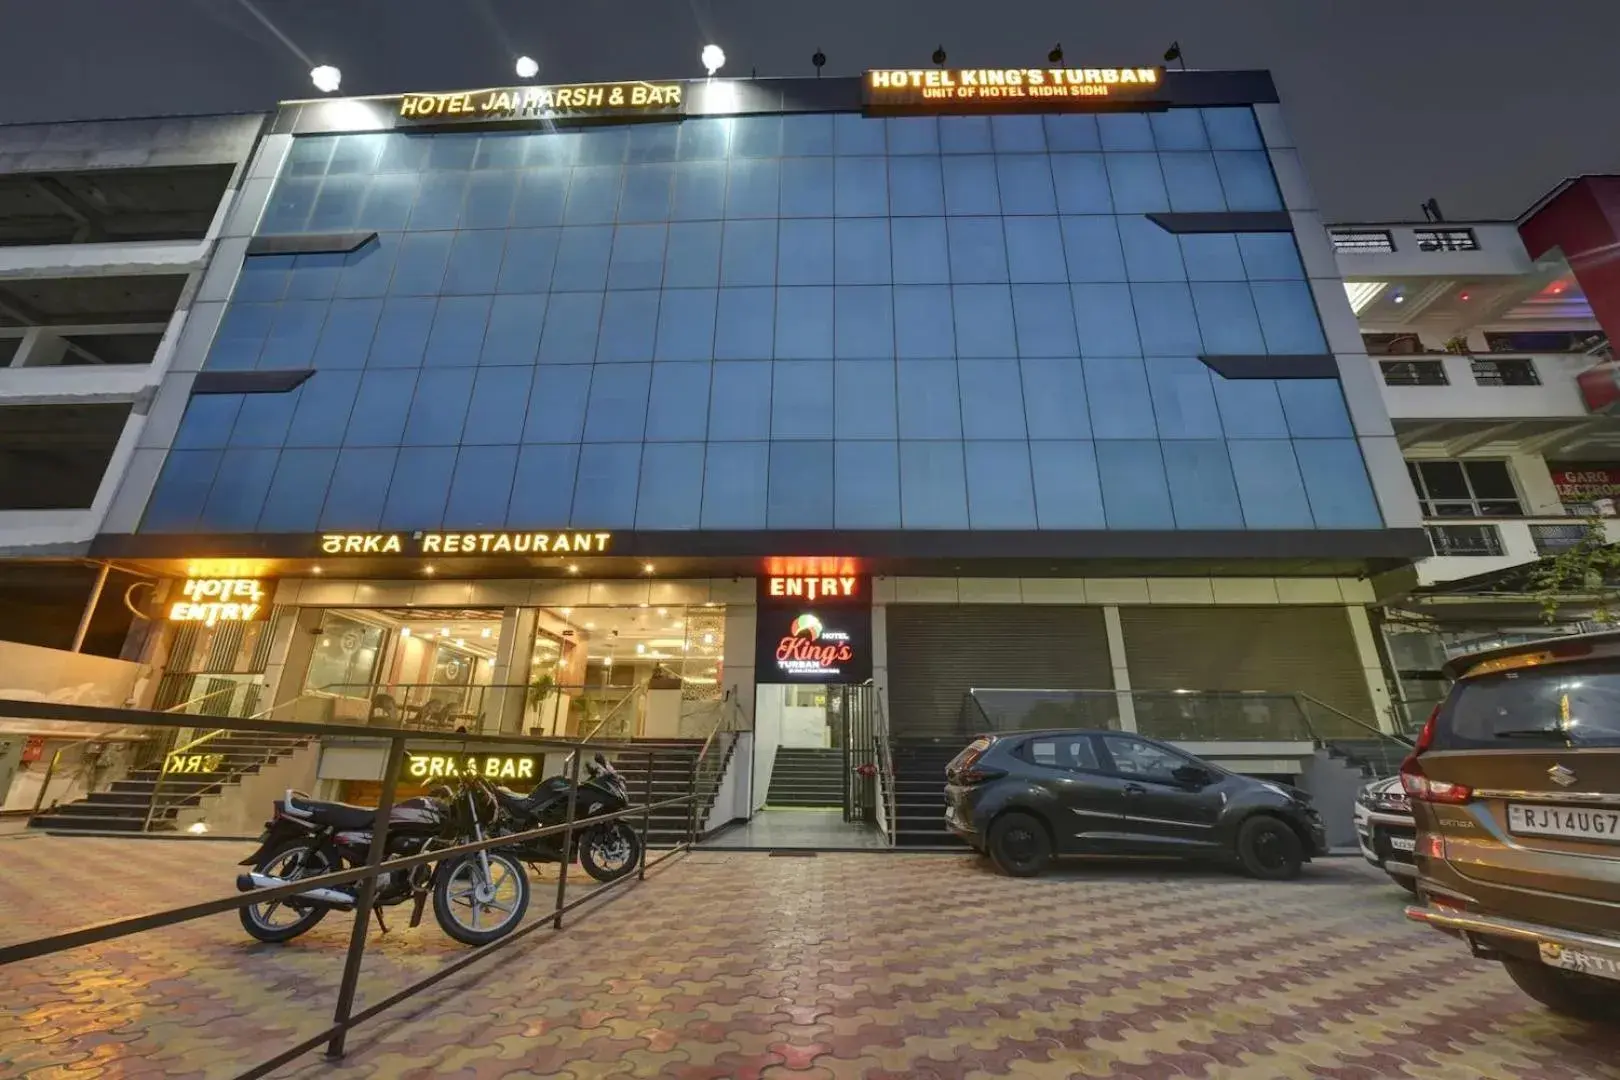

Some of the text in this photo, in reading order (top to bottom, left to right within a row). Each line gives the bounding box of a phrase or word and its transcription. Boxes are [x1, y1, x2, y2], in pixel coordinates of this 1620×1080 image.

[871, 68, 1157, 88] HOTEL KING'S TURBAN
[400, 95, 475, 116] HOTEL
[522, 88, 602, 110] HARSH
[607, 87, 625, 105] &
[631, 85, 682, 105] BAR
[923, 84, 1108, 98] UNIT OF HOTEL RIDHI SIDHI
[423, 533, 611, 552] RESTAURANT
[183, 579, 265, 602] HOTEL
[770, 577, 856, 600] ENTRY
[169, 603, 260, 628] ENTRY
[822, 632, 850, 640] HOTEL
[776, 636, 852, 667] King's
[777, 660, 819, 669] TURBAN
[485, 757, 534, 778] BAR
